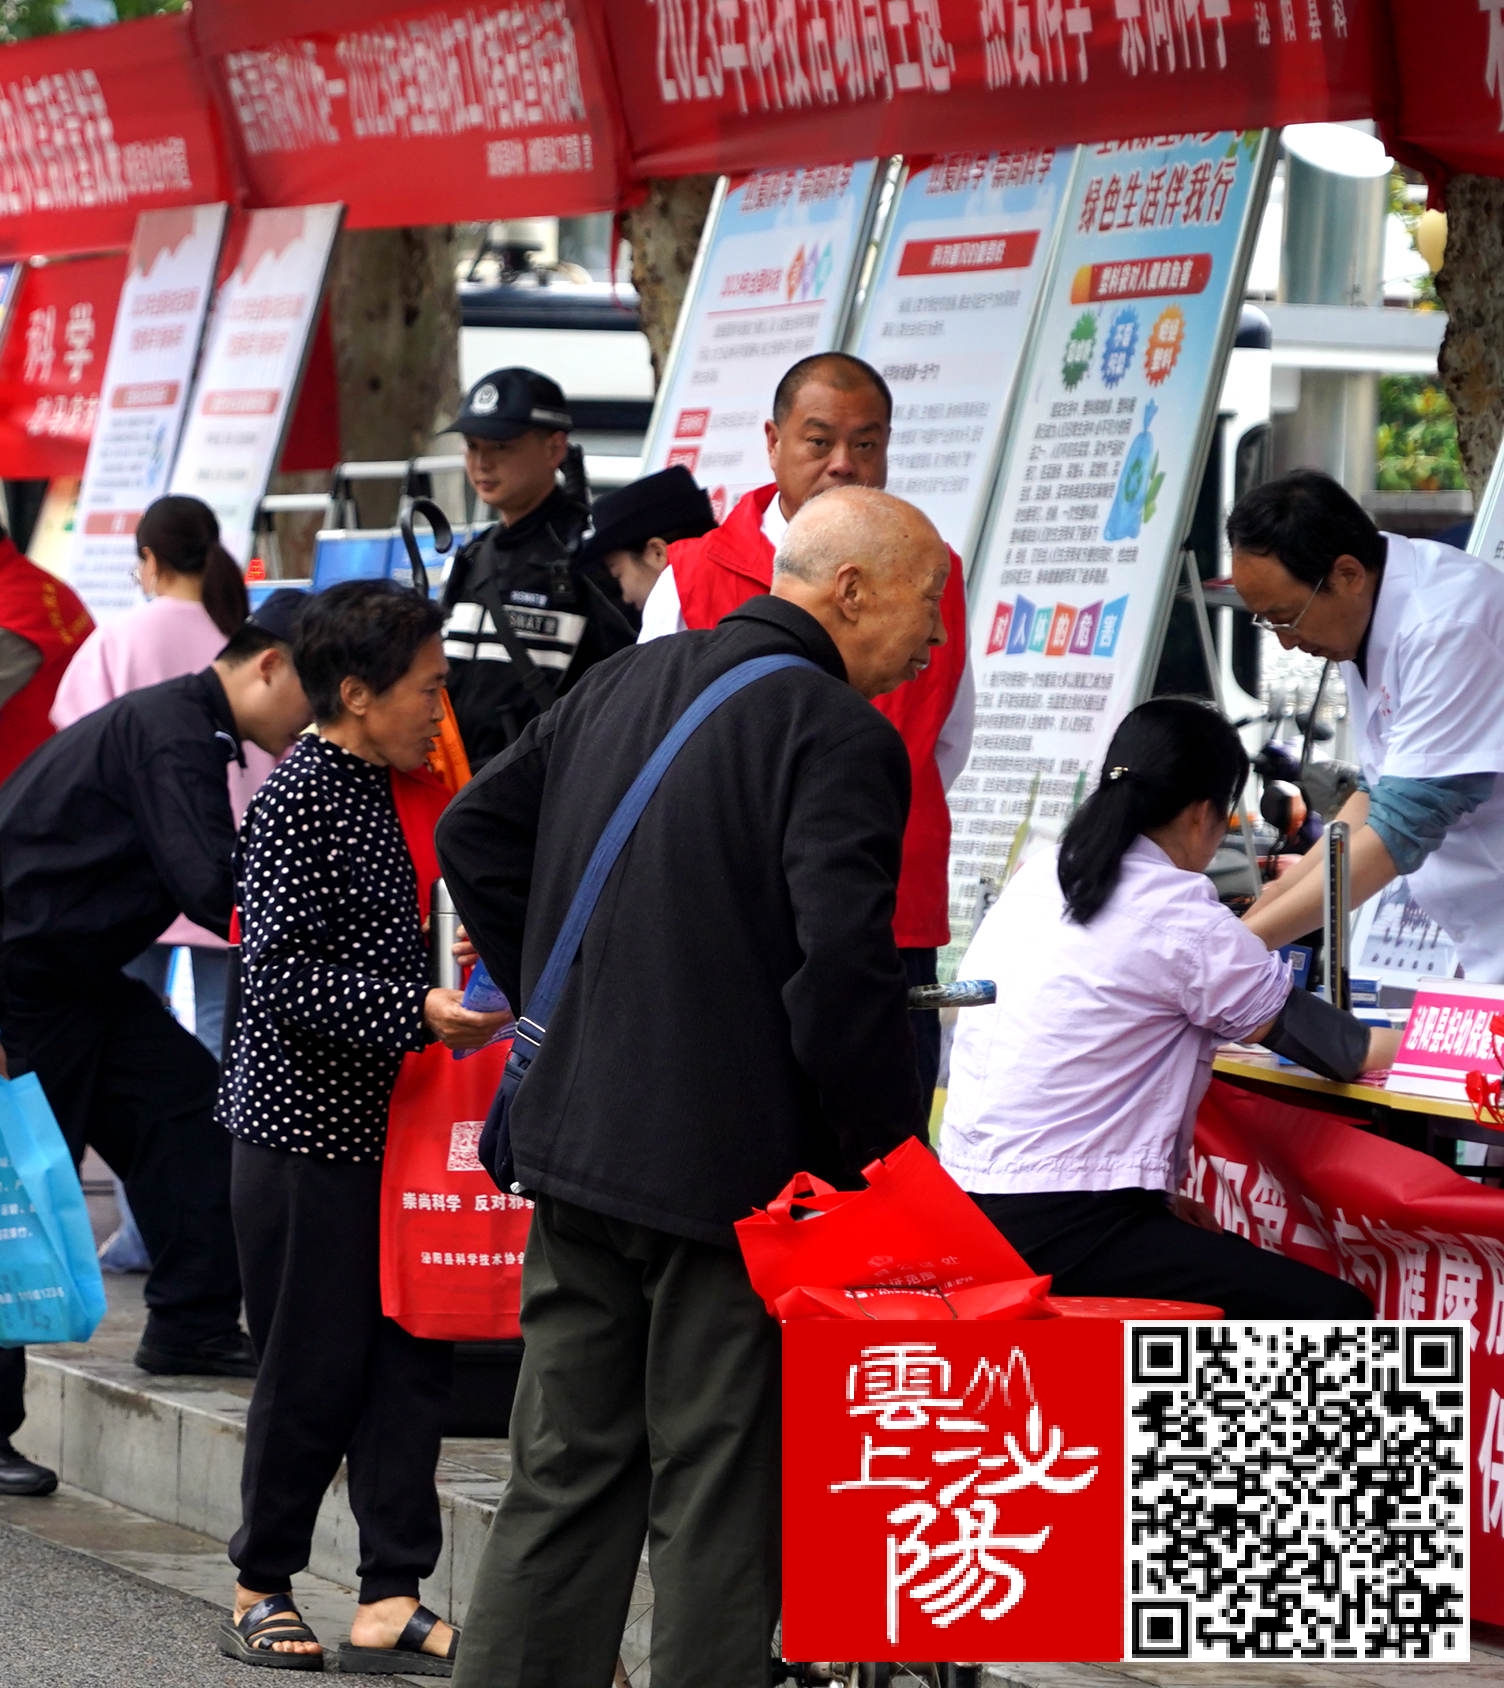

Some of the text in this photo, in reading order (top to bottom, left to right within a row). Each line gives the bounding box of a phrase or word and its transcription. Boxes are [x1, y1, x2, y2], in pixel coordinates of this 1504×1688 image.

[1077, 157, 1238, 234] 绿色生活伴我行
[1405, 1005, 1504, 1061] 泌阳县妇幼保健
[402, 1192, 462, 1212] 崇尚科学
